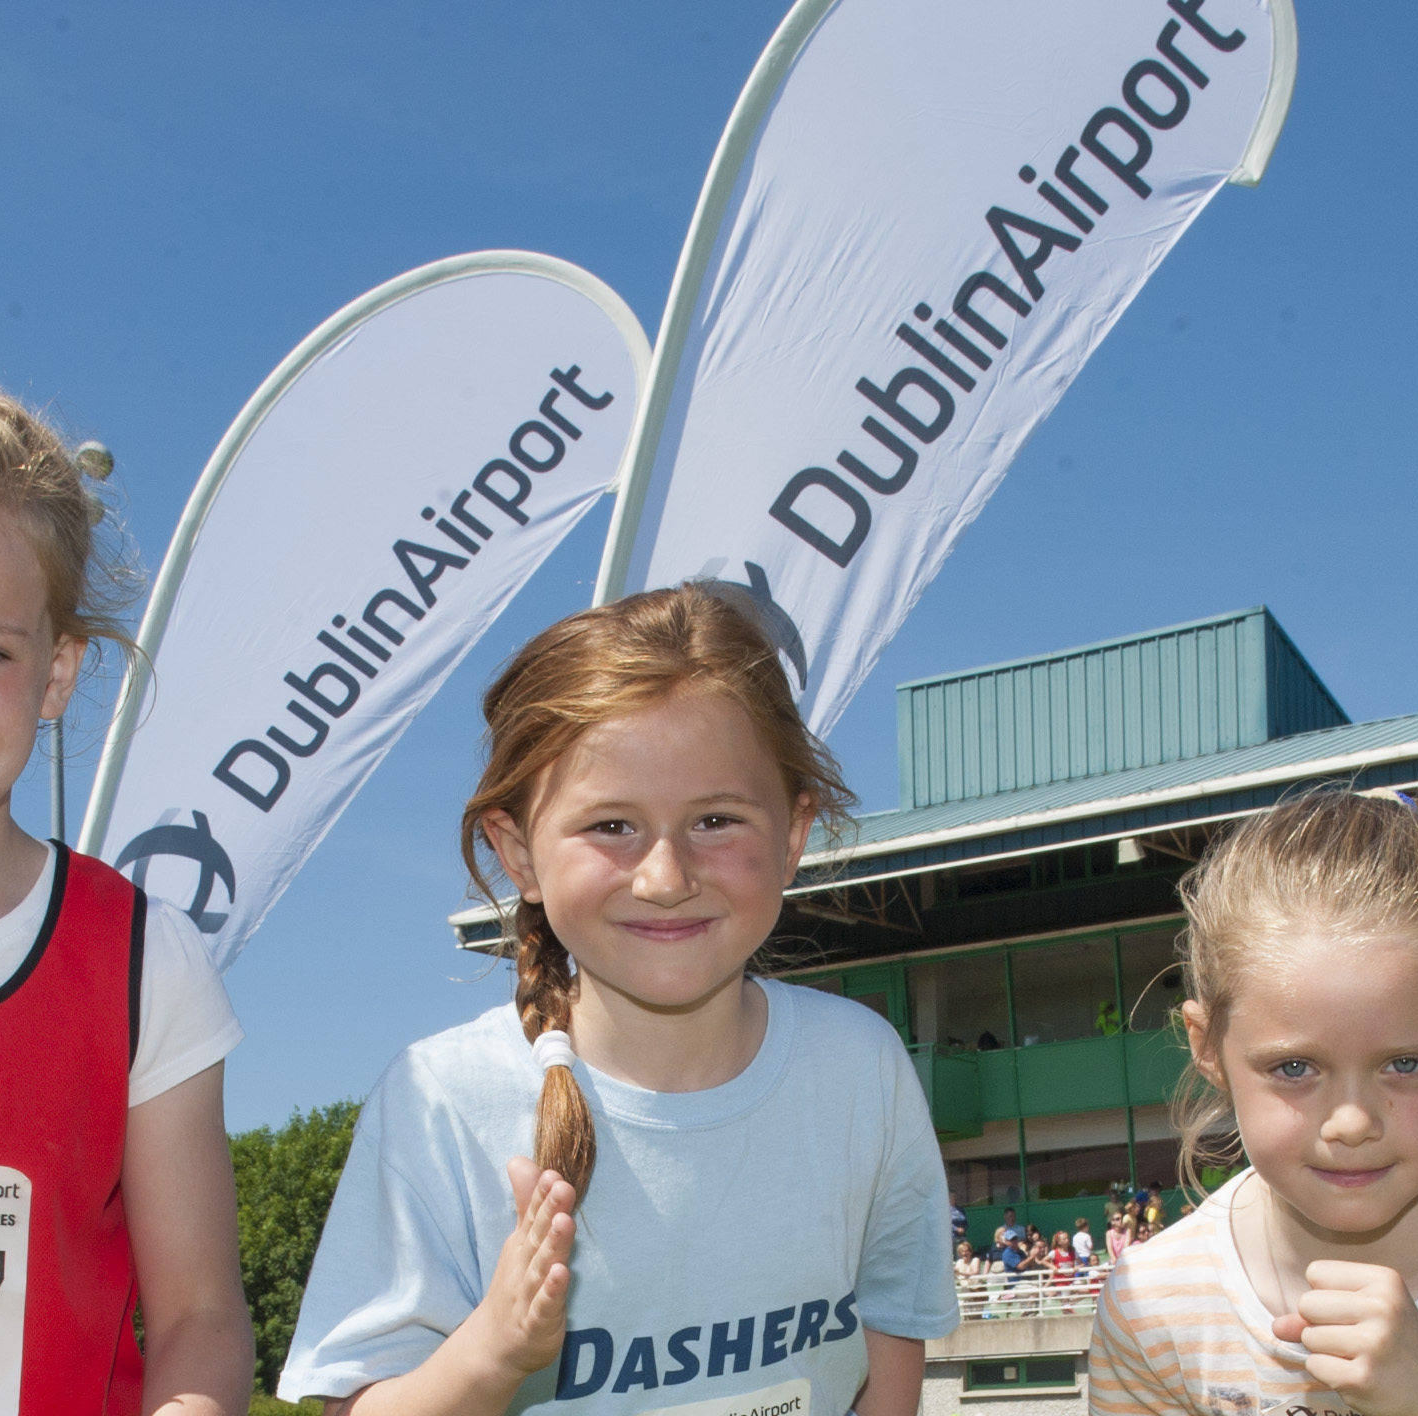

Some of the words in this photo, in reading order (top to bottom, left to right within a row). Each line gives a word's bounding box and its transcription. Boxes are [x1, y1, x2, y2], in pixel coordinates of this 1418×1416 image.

[769, 0, 1246, 569] DublinAirport
[212, 364, 614, 813] DublinAirport
[555, 1290, 859, 1401] DASHERS
